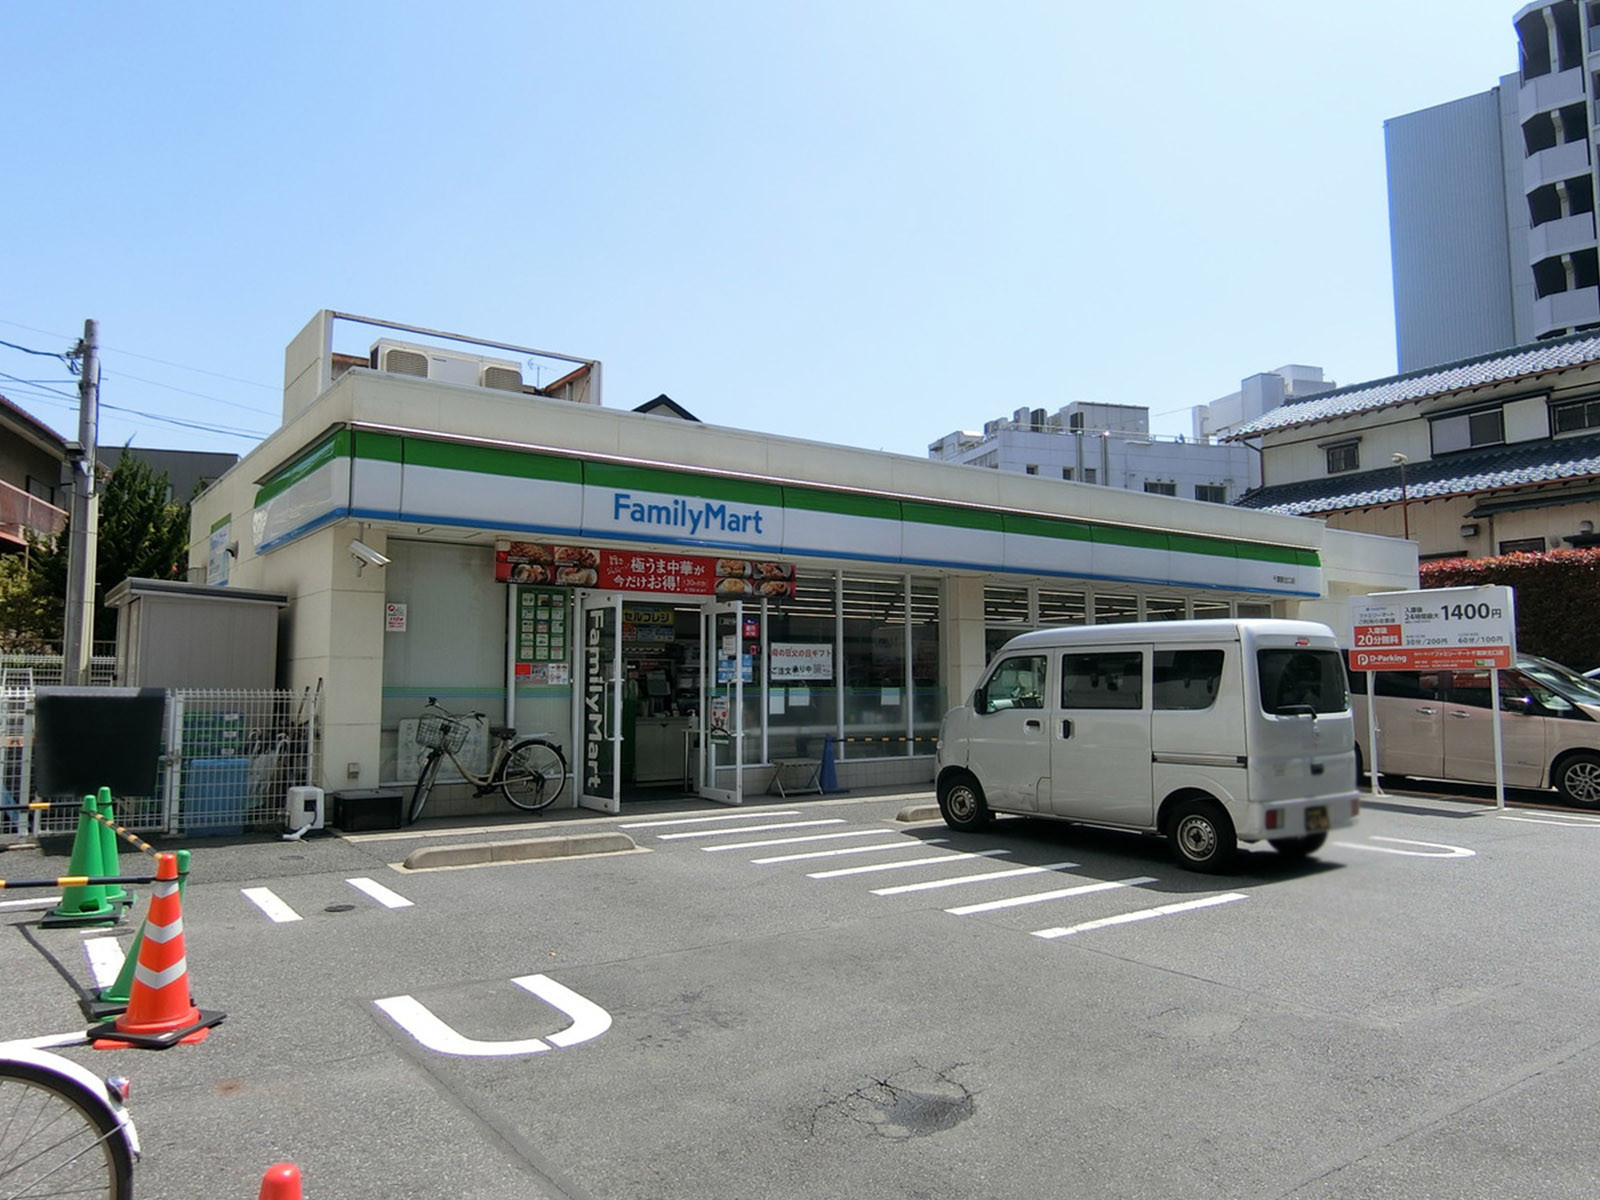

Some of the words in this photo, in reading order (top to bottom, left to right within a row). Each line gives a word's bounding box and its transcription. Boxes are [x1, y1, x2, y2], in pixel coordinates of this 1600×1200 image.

[613, 493, 763, 535] FamilyMart
[631, 556, 705, 576] 極うま中華が
[624, 611, 670, 623] セルフレジ
[1441, 603, 1502, 621] 1400円
[1357, 634, 1399, 646] 20分無料
[1370, 654, 1408, 663] D-Parking
[585, 609, 604, 789] FamilyMart
